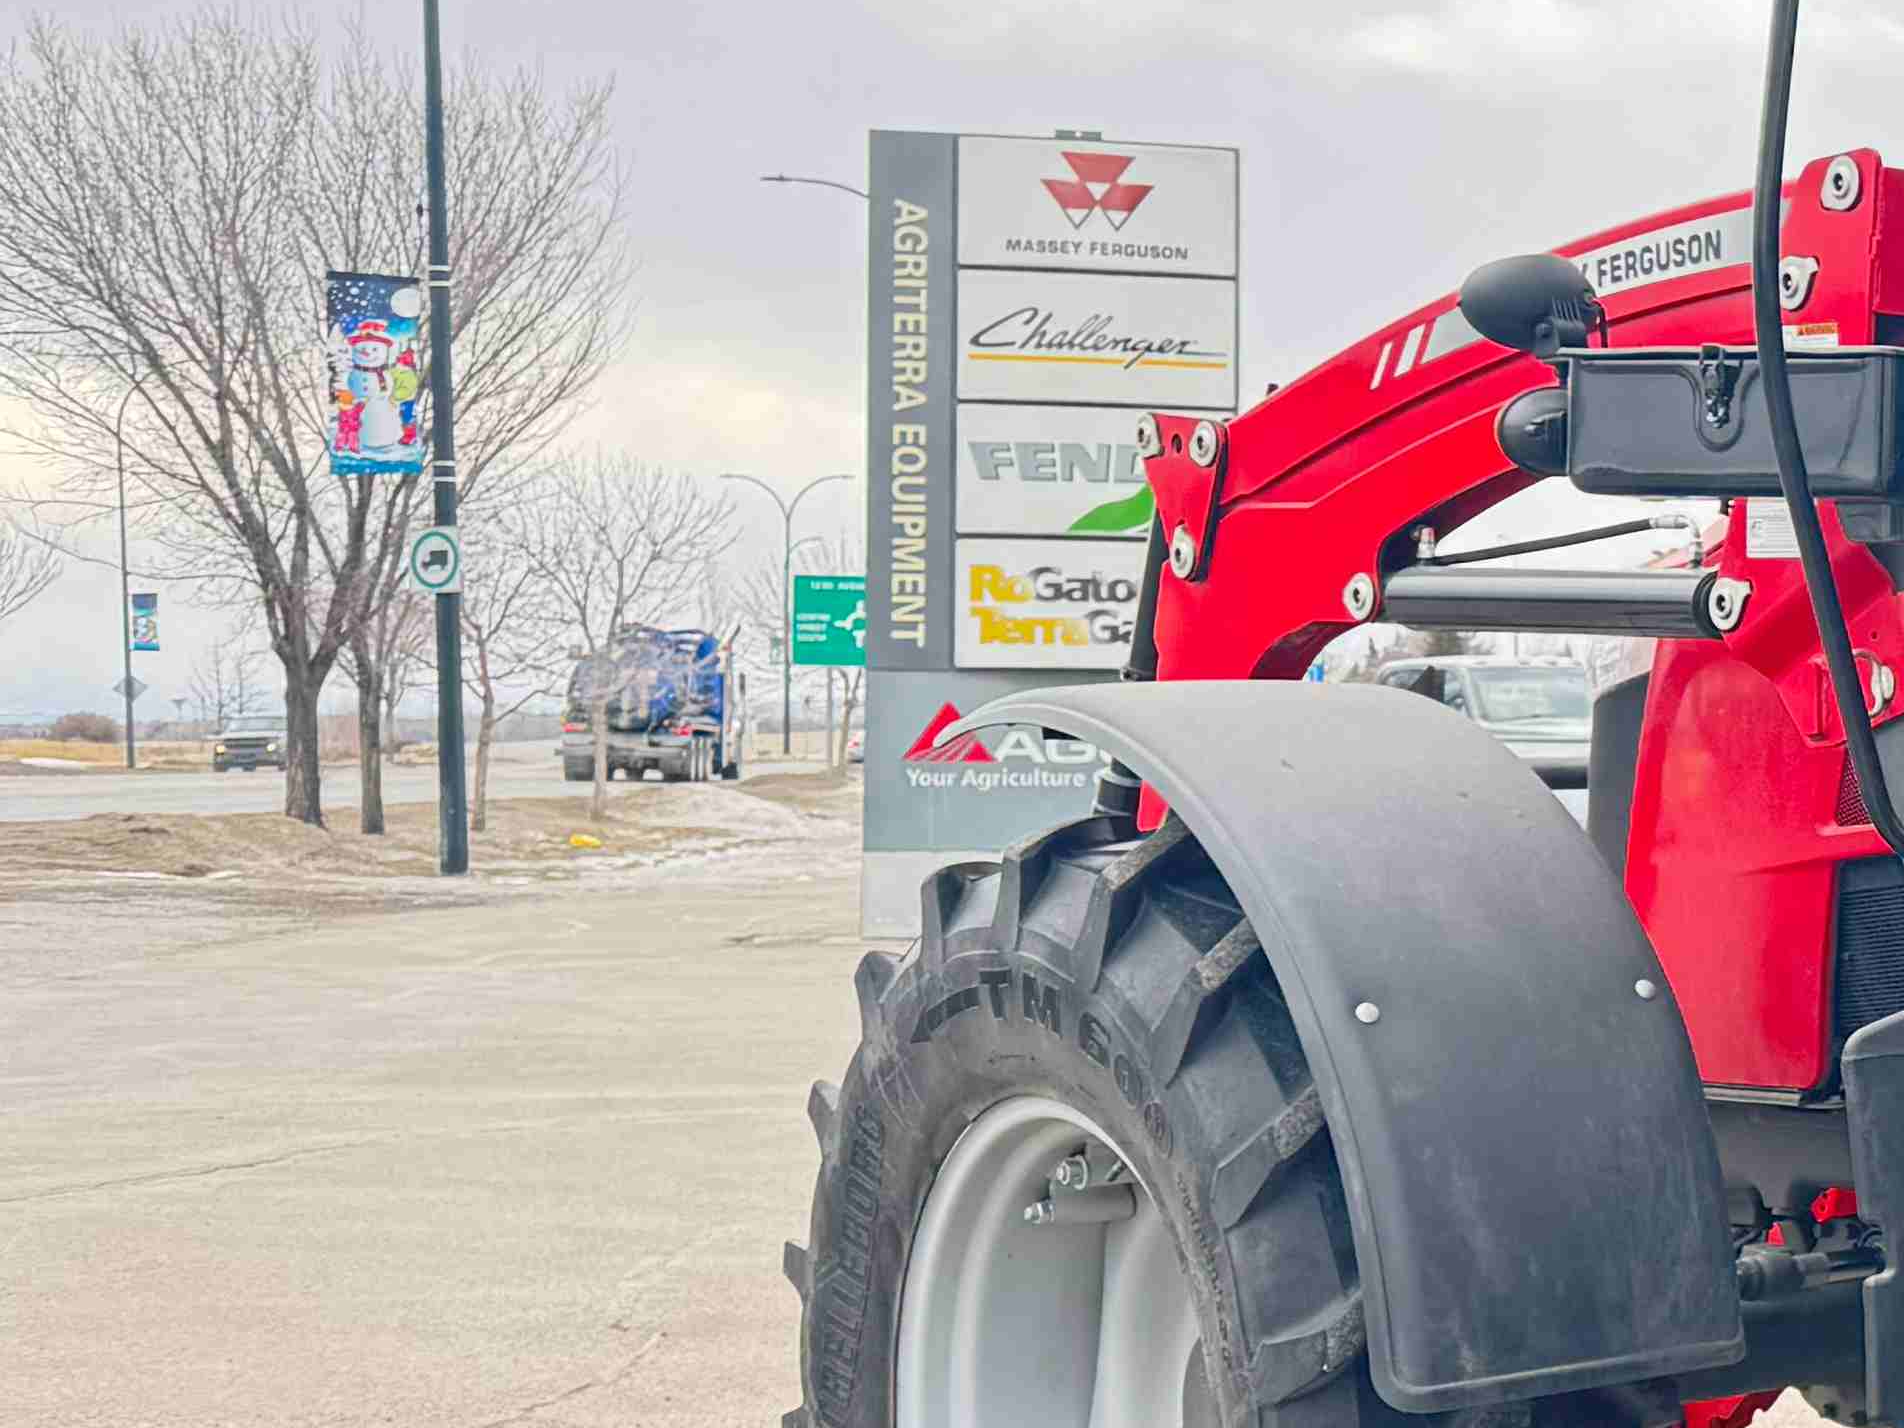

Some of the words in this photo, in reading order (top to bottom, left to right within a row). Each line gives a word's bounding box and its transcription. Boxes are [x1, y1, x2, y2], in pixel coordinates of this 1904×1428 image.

[1004, 238, 1083, 256] MASSEY
[1089, 240, 1189, 260] FERGUSON
[1597, 228, 1722, 288] FERGUSON
[892, 197, 929, 412] AGRITERRA
[967, 307, 1202, 370] Challenger
[967, 441, 1146, 484] FEND
[889, 423, 929, 651] EQUIPMENT
[968, 563, 1138, 603] RoGato
[904, 768, 956, 789] Your
[960, 768, 1087, 792] Agriculture
[977, 968, 1064, 1039] TM
